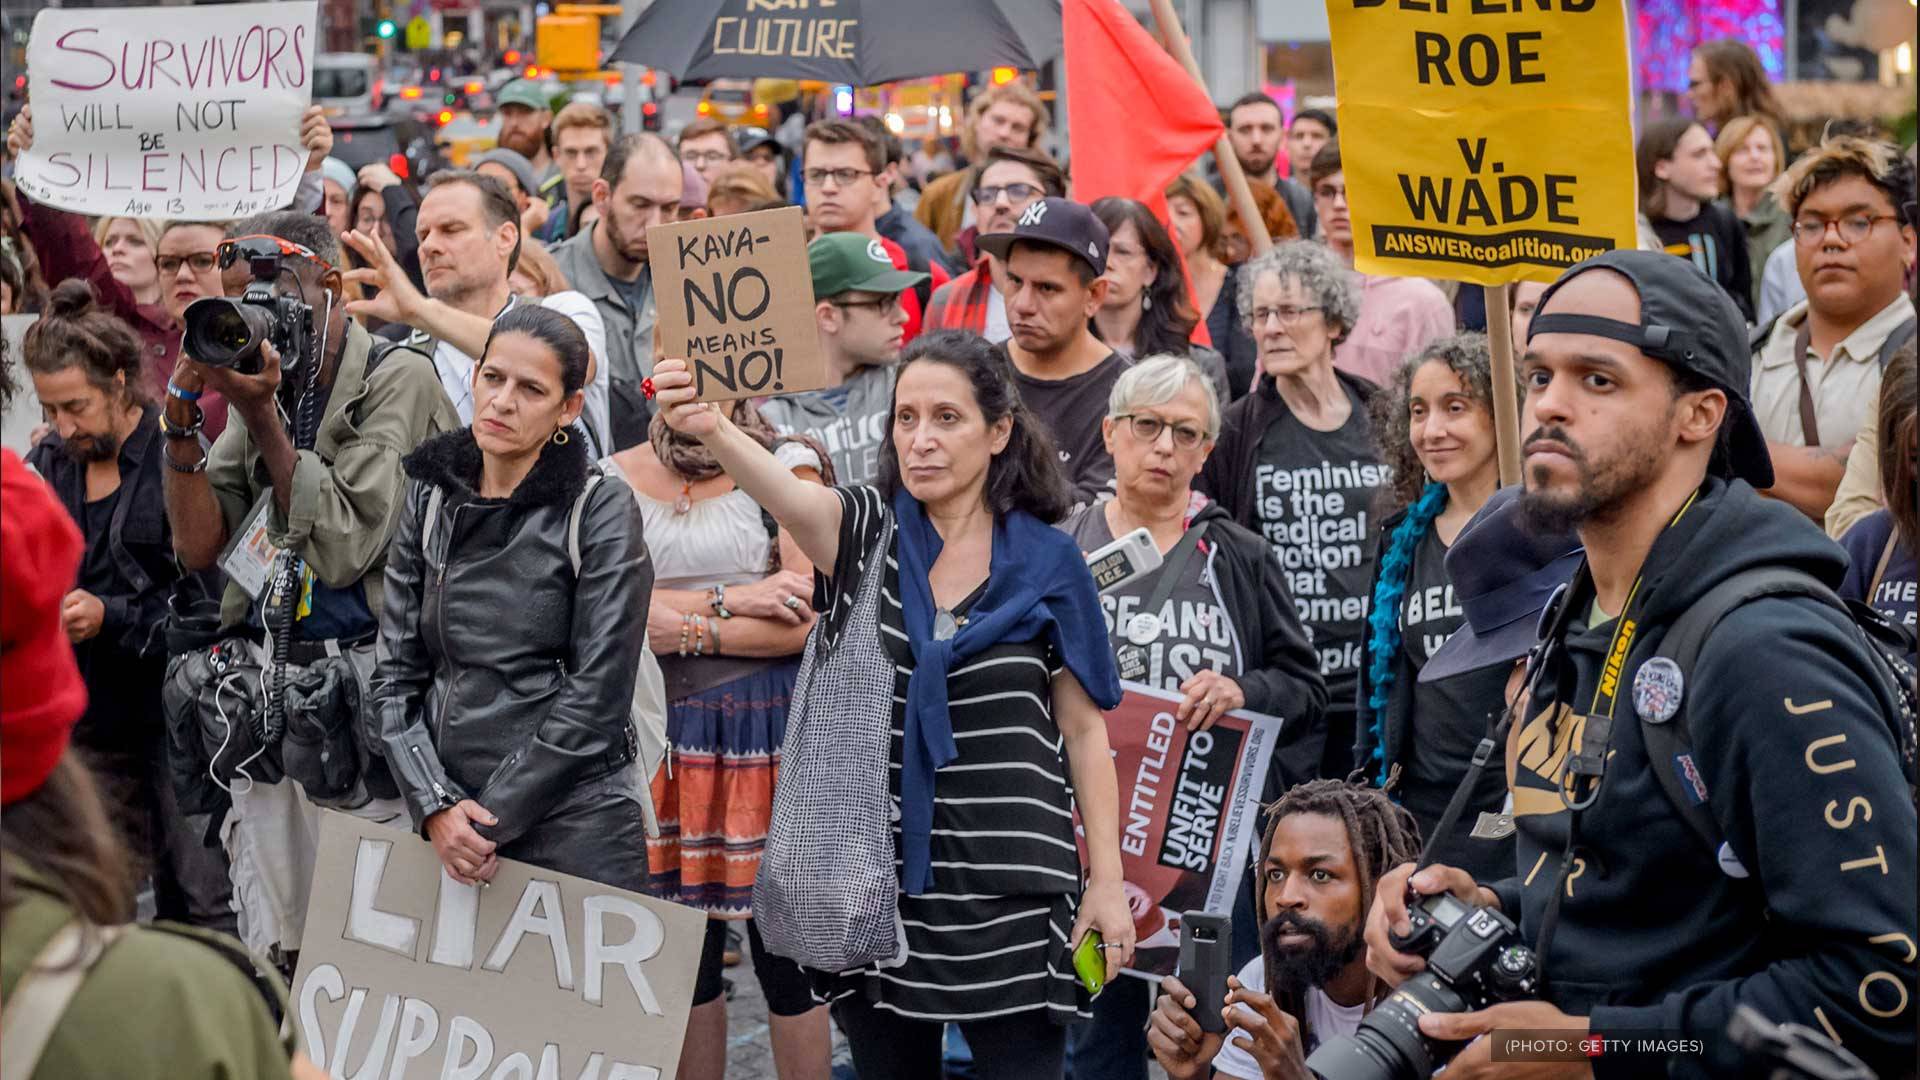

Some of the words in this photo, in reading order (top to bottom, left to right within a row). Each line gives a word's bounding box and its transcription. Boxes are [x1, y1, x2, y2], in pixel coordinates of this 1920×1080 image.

[50, 24, 305, 91] SURVIVORS
[713, 16, 858, 58] CULTURE
[1414, 30, 1546, 87] ROE
[60, 103, 134, 132] WILL
[176, 99, 246, 132] NOT
[138, 133, 165, 152] BE
[38, 144, 301, 193] SILENCED
[125, 198, 152, 214] Age
[166, 197, 185, 214] 13
[232, 198, 257, 216] Age
[1397, 173, 1579, 227] WADE
[677, 227, 770, 270] KAVA-
[683, 266, 771, 327] NO
[686, 327, 776, 357] MEANS
[694, 348, 784, 397] NO!
[1256, 489, 1284, 519] is
[1289, 487, 1345, 517] the
[1262, 510, 1366, 545] radical
[1272, 541, 1362, 570] notion
[1284, 568, 1327, 595] at
[1158, 598, 1232, 648] AND
[1294, 595, 1369, 621] ome
[1601, 618, 1637, 698] Nikon
[1121, 711, 1177, 857] ENTITLED
[1162, 771, 1201, 866] UNFIT
[1184, 730, 1215, 771] TO
[1784, 697, 1889, 875] JUST
[1185, 783, 1225, 873] SERVE
[342, 836, 664, 1017] LIAR
